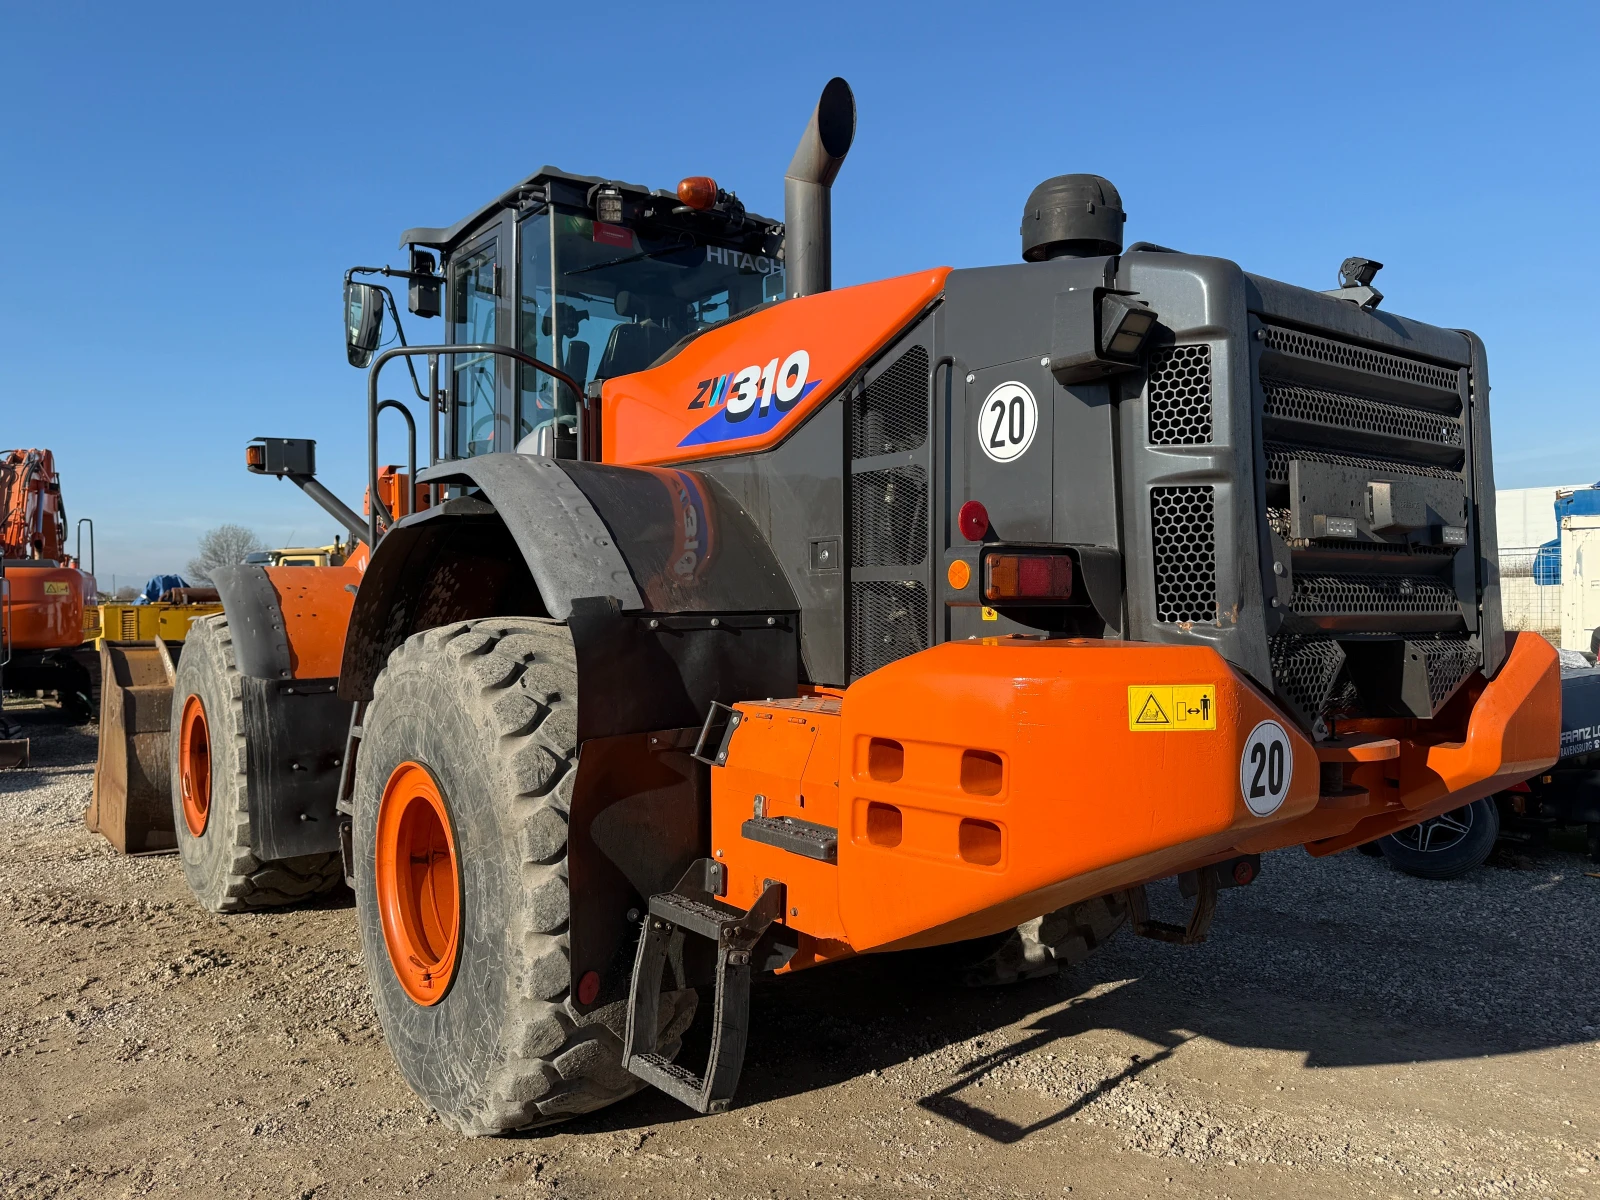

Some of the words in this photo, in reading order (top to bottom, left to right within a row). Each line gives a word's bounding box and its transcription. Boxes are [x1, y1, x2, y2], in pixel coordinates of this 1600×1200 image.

[706, 244, 785, 276] HITACH
[990, 396, 1024, 448] 20
[1560, 726, 1591, 745] FRANZ
[1560, 740, 1592, 757] RAVENSBURG
[1250, 739, 1284, 799] 20
